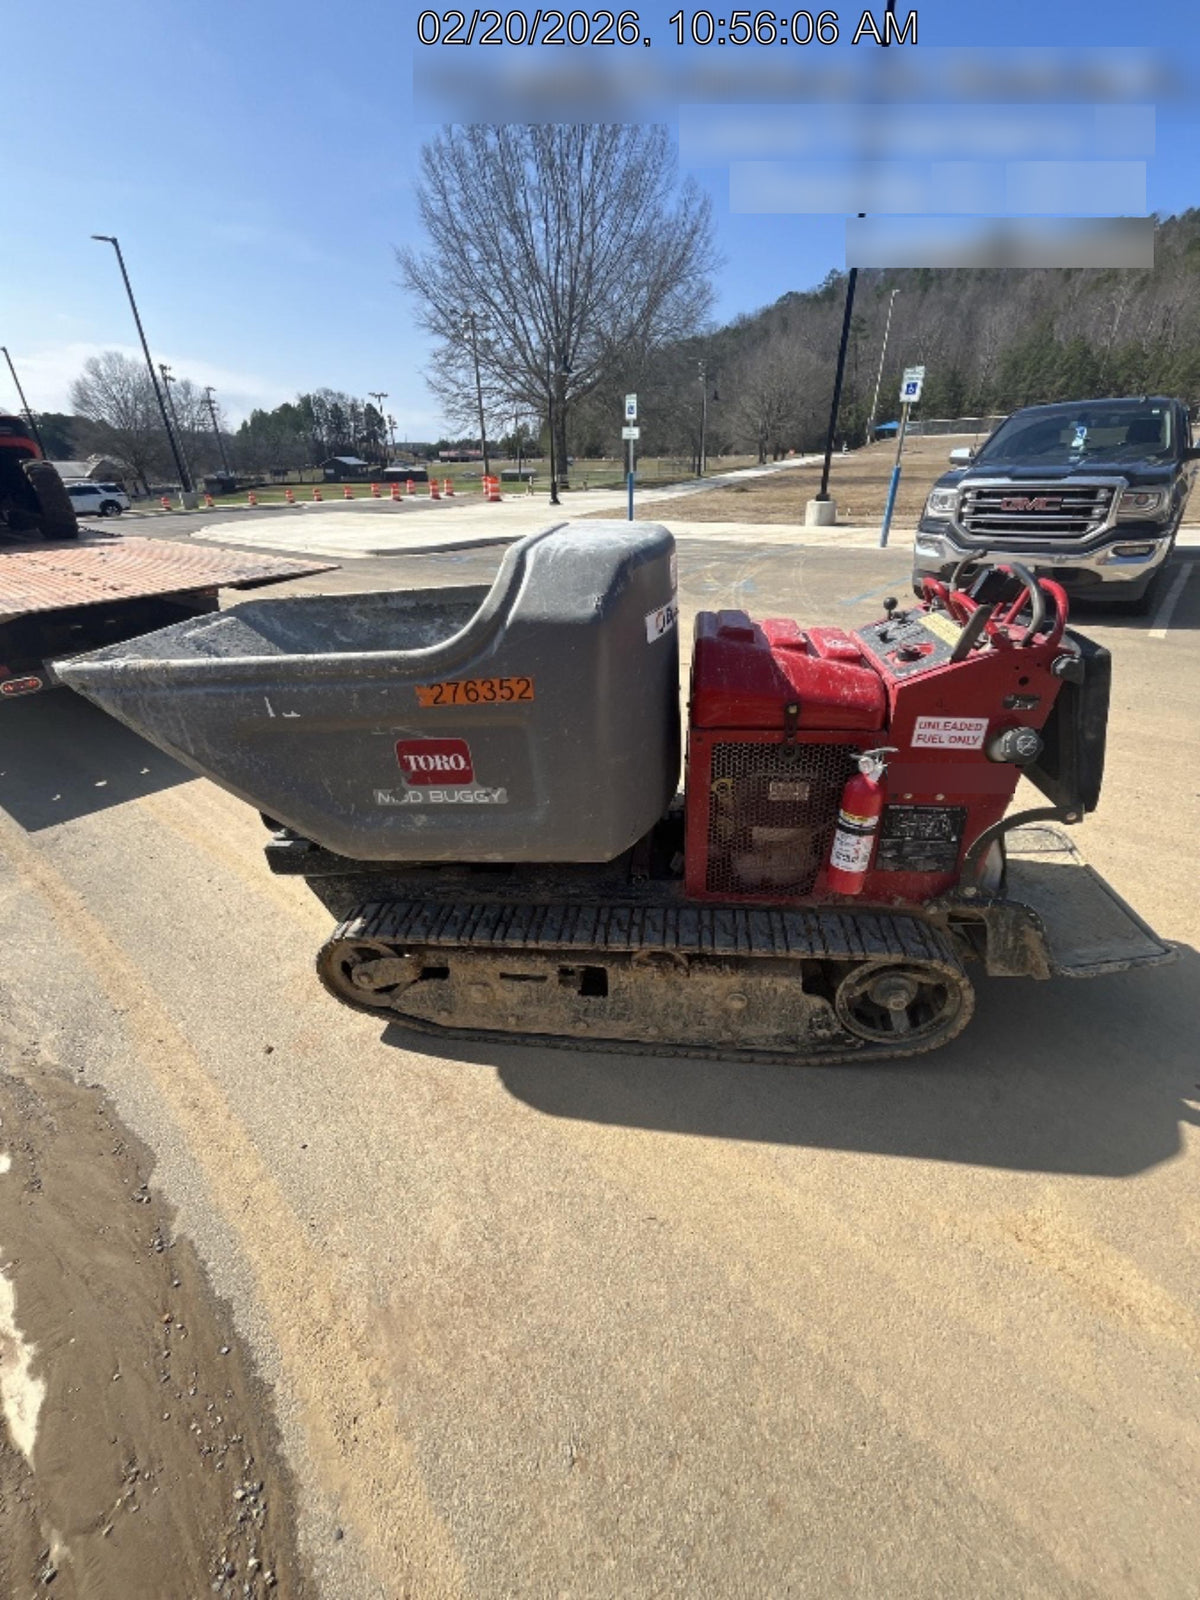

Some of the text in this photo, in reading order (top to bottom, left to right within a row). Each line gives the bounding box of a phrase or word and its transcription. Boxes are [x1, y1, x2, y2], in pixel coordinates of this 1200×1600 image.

[1000, 497, 1062, 511] GMC
[429, 678, 533, 705] 276352
[918, 721, 983, 732] UNLEADED
[915, 733, 981, 746] FUEL ONLY
[403, 754, 466, 771] TORO
[428, 788, 503, 804] BUGGY
